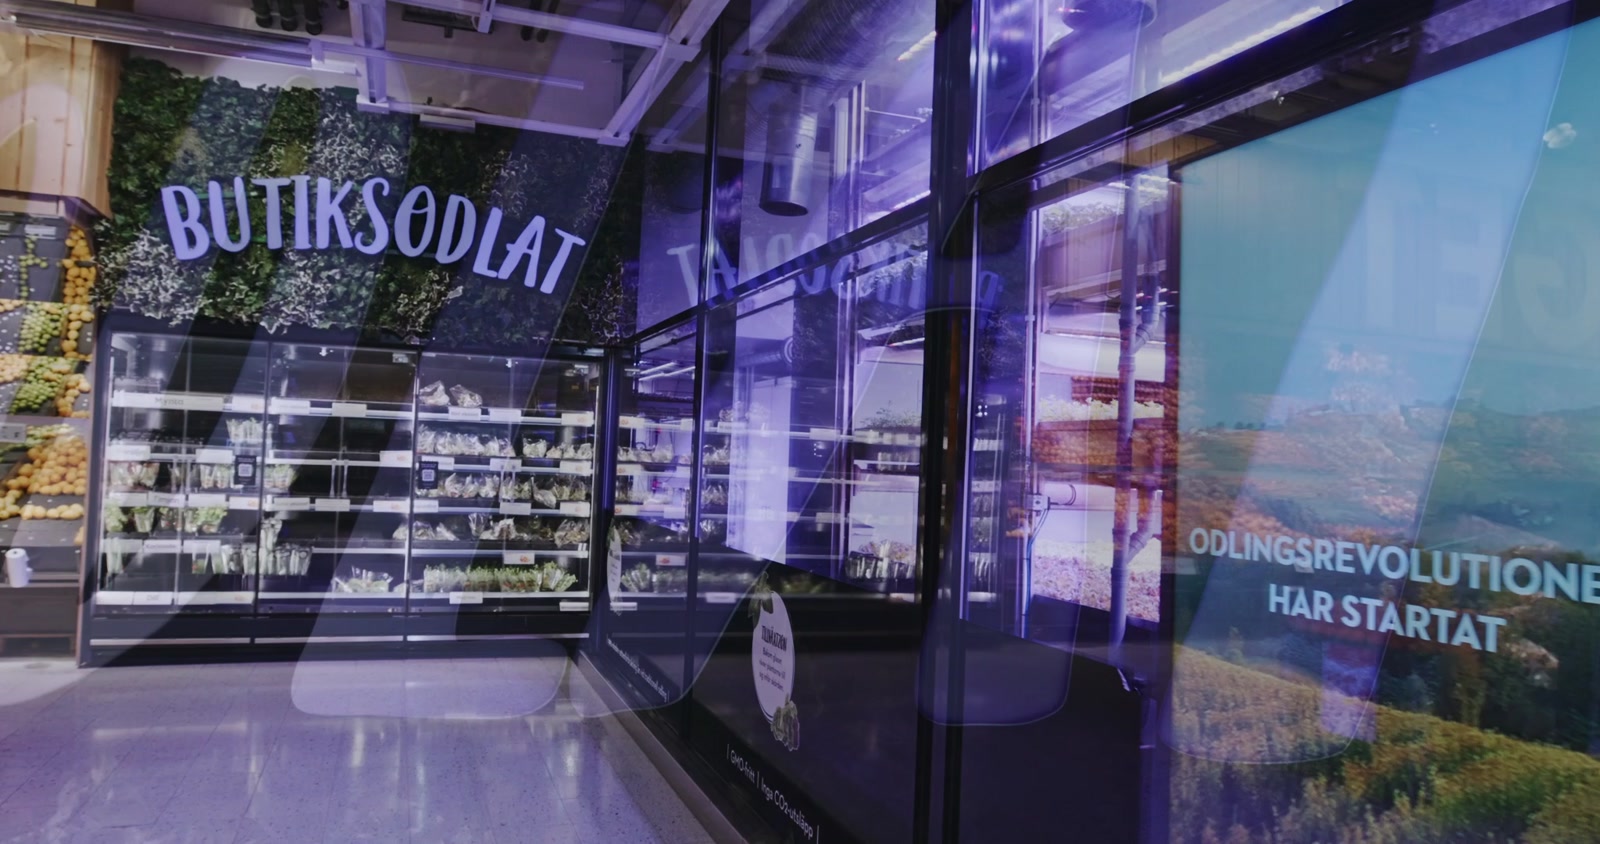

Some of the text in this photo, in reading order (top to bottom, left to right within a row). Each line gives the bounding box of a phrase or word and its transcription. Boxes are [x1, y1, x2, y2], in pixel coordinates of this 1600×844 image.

[161, 175, 586, 294] BUTIKSODLAT
[1189, 527, 1600, 604] ODLINGSREVOLUTIONE
[1269, 583, 1507, 653] HAR STARTAT
[730, 749, 755, 783] GMO-fritt
[761, 777, 774, 801] Inga
